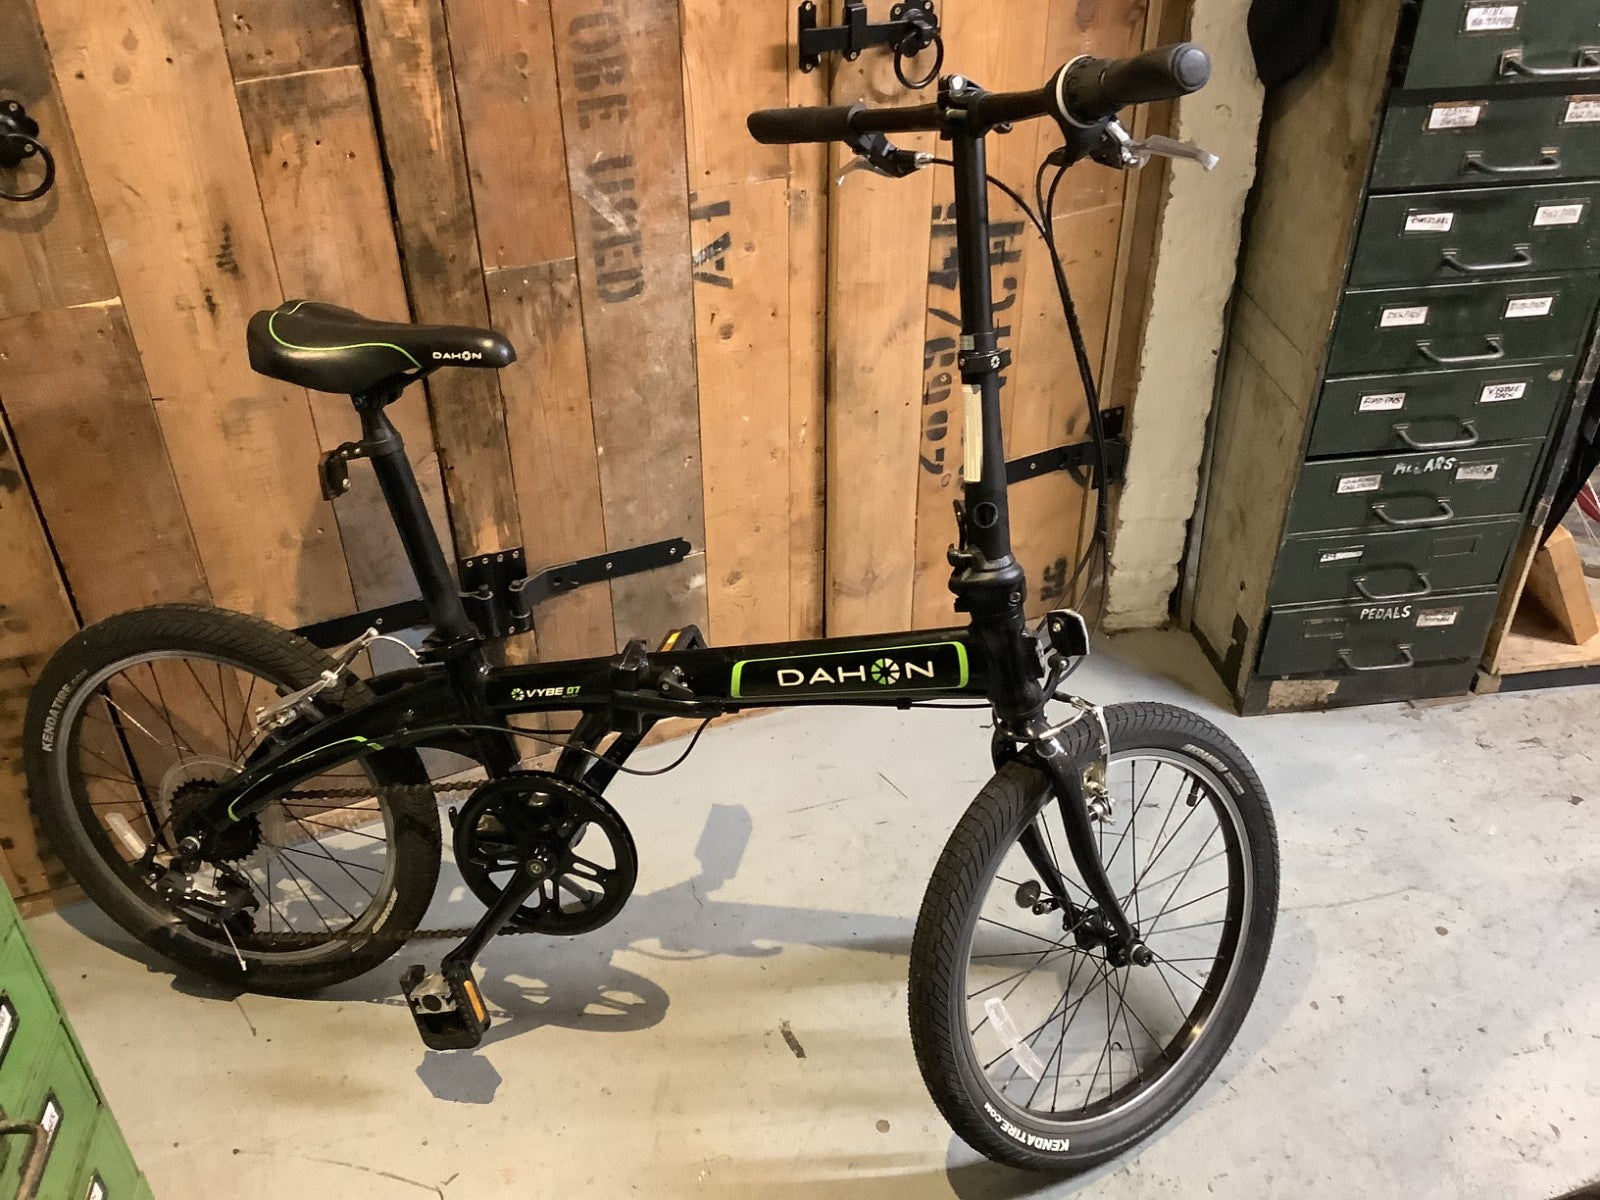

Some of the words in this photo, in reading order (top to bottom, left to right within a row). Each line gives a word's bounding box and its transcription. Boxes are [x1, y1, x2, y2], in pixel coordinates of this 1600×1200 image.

[432, 350, 482, 361] DAHON
[1359, 605, 1412, 620] PEDALS
[776, 657, 935, 687] DAHON
[526, 686, 564, 698] VYBE
[566, 685, 581, 695] 07
